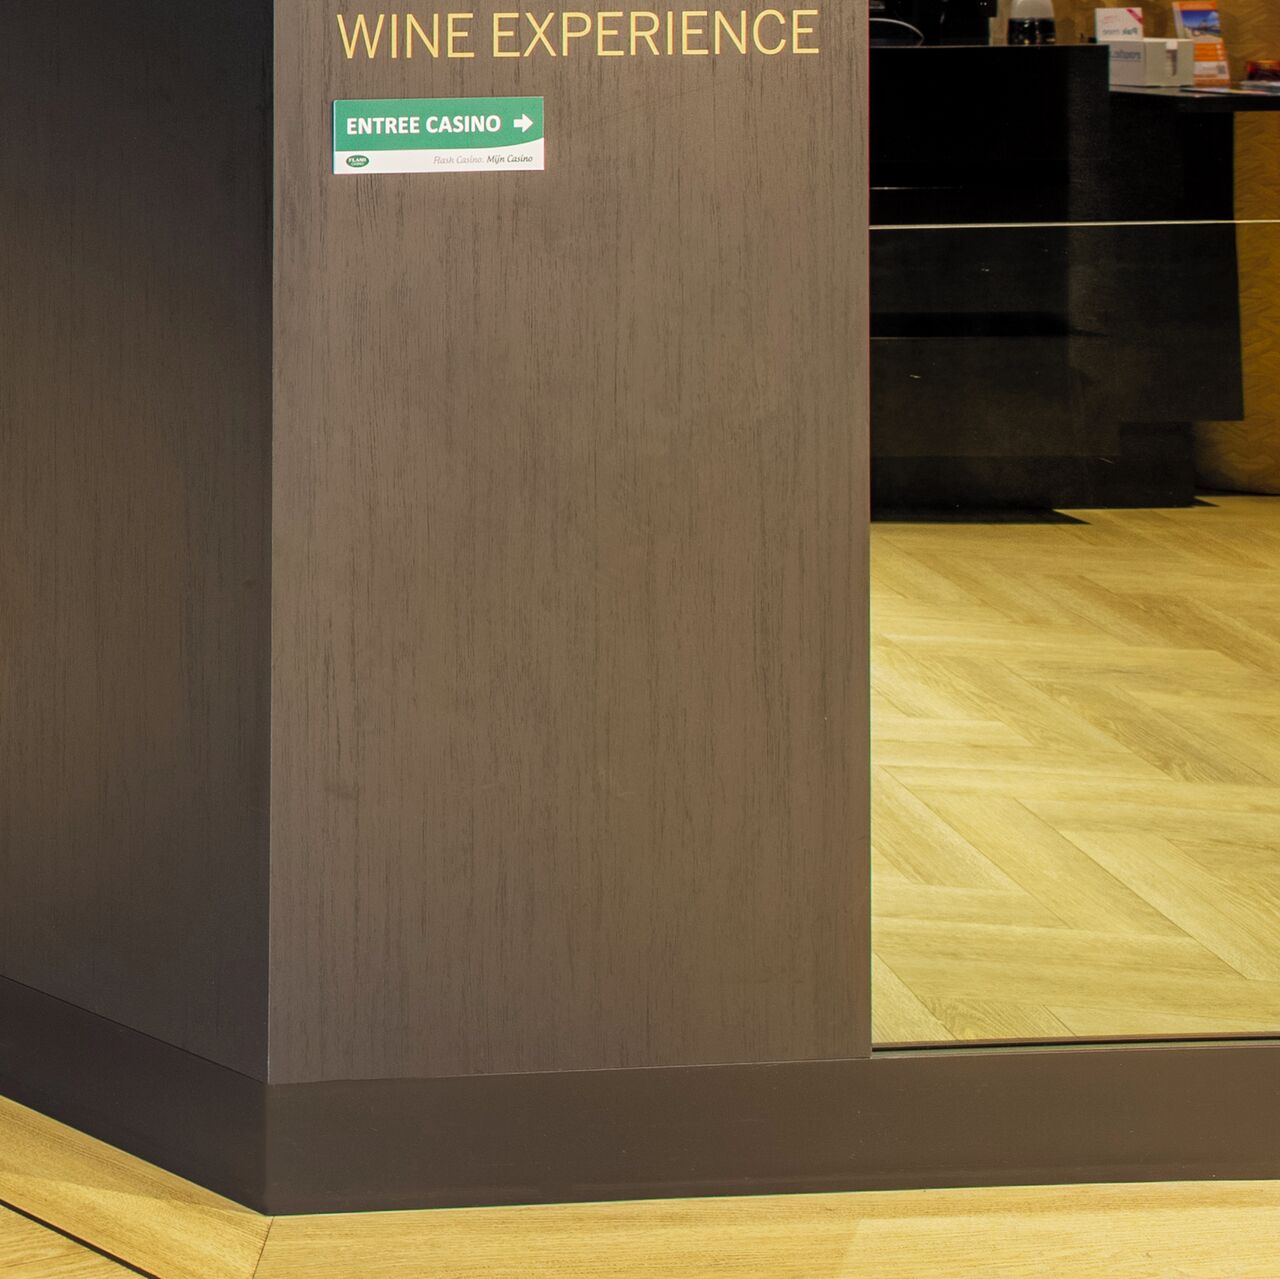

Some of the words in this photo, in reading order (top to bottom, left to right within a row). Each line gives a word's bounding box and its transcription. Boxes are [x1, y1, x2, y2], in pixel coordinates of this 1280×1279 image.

[336, 12, 475, 58] WINE
[492, 9, 820, 57] EXPERIENCE
[346, 116, 420, 135] ENTREE
[425, 115, 501, 133] CASINO
[487, 155, 505, 165] Mijn
[507, 154, 533, 163] Casino
